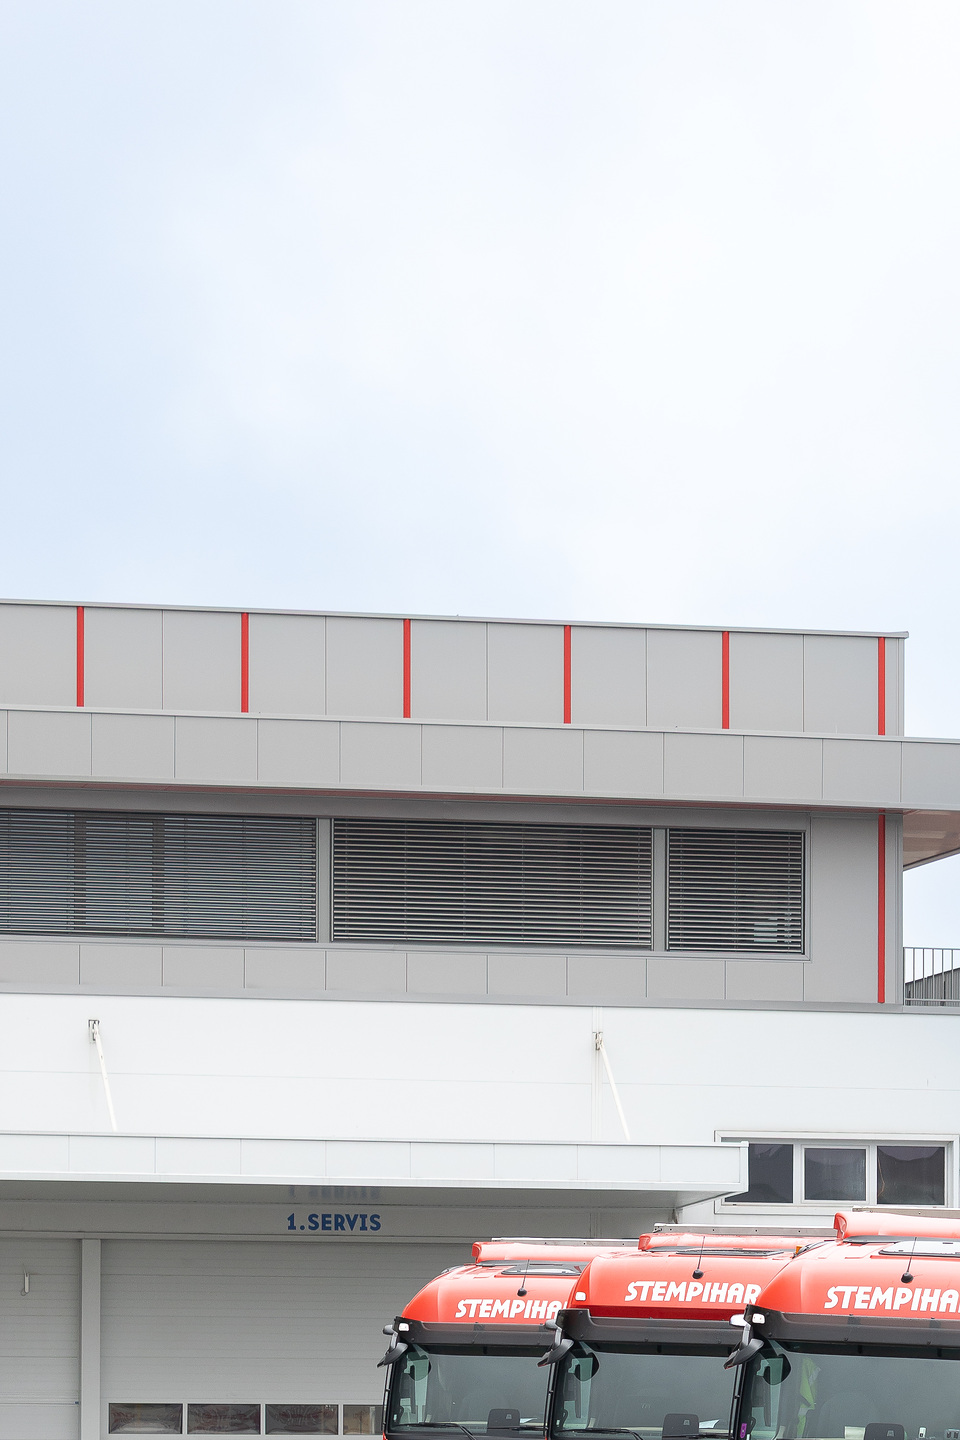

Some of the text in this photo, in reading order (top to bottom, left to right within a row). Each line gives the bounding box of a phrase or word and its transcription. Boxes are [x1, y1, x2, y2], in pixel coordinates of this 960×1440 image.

[287, 1213, 382, 1231] 1.SERVIS
[624, 1280, 762, 1305] STEMPIHAR
[454, 1298, 568, 1320] STEMPIHA
